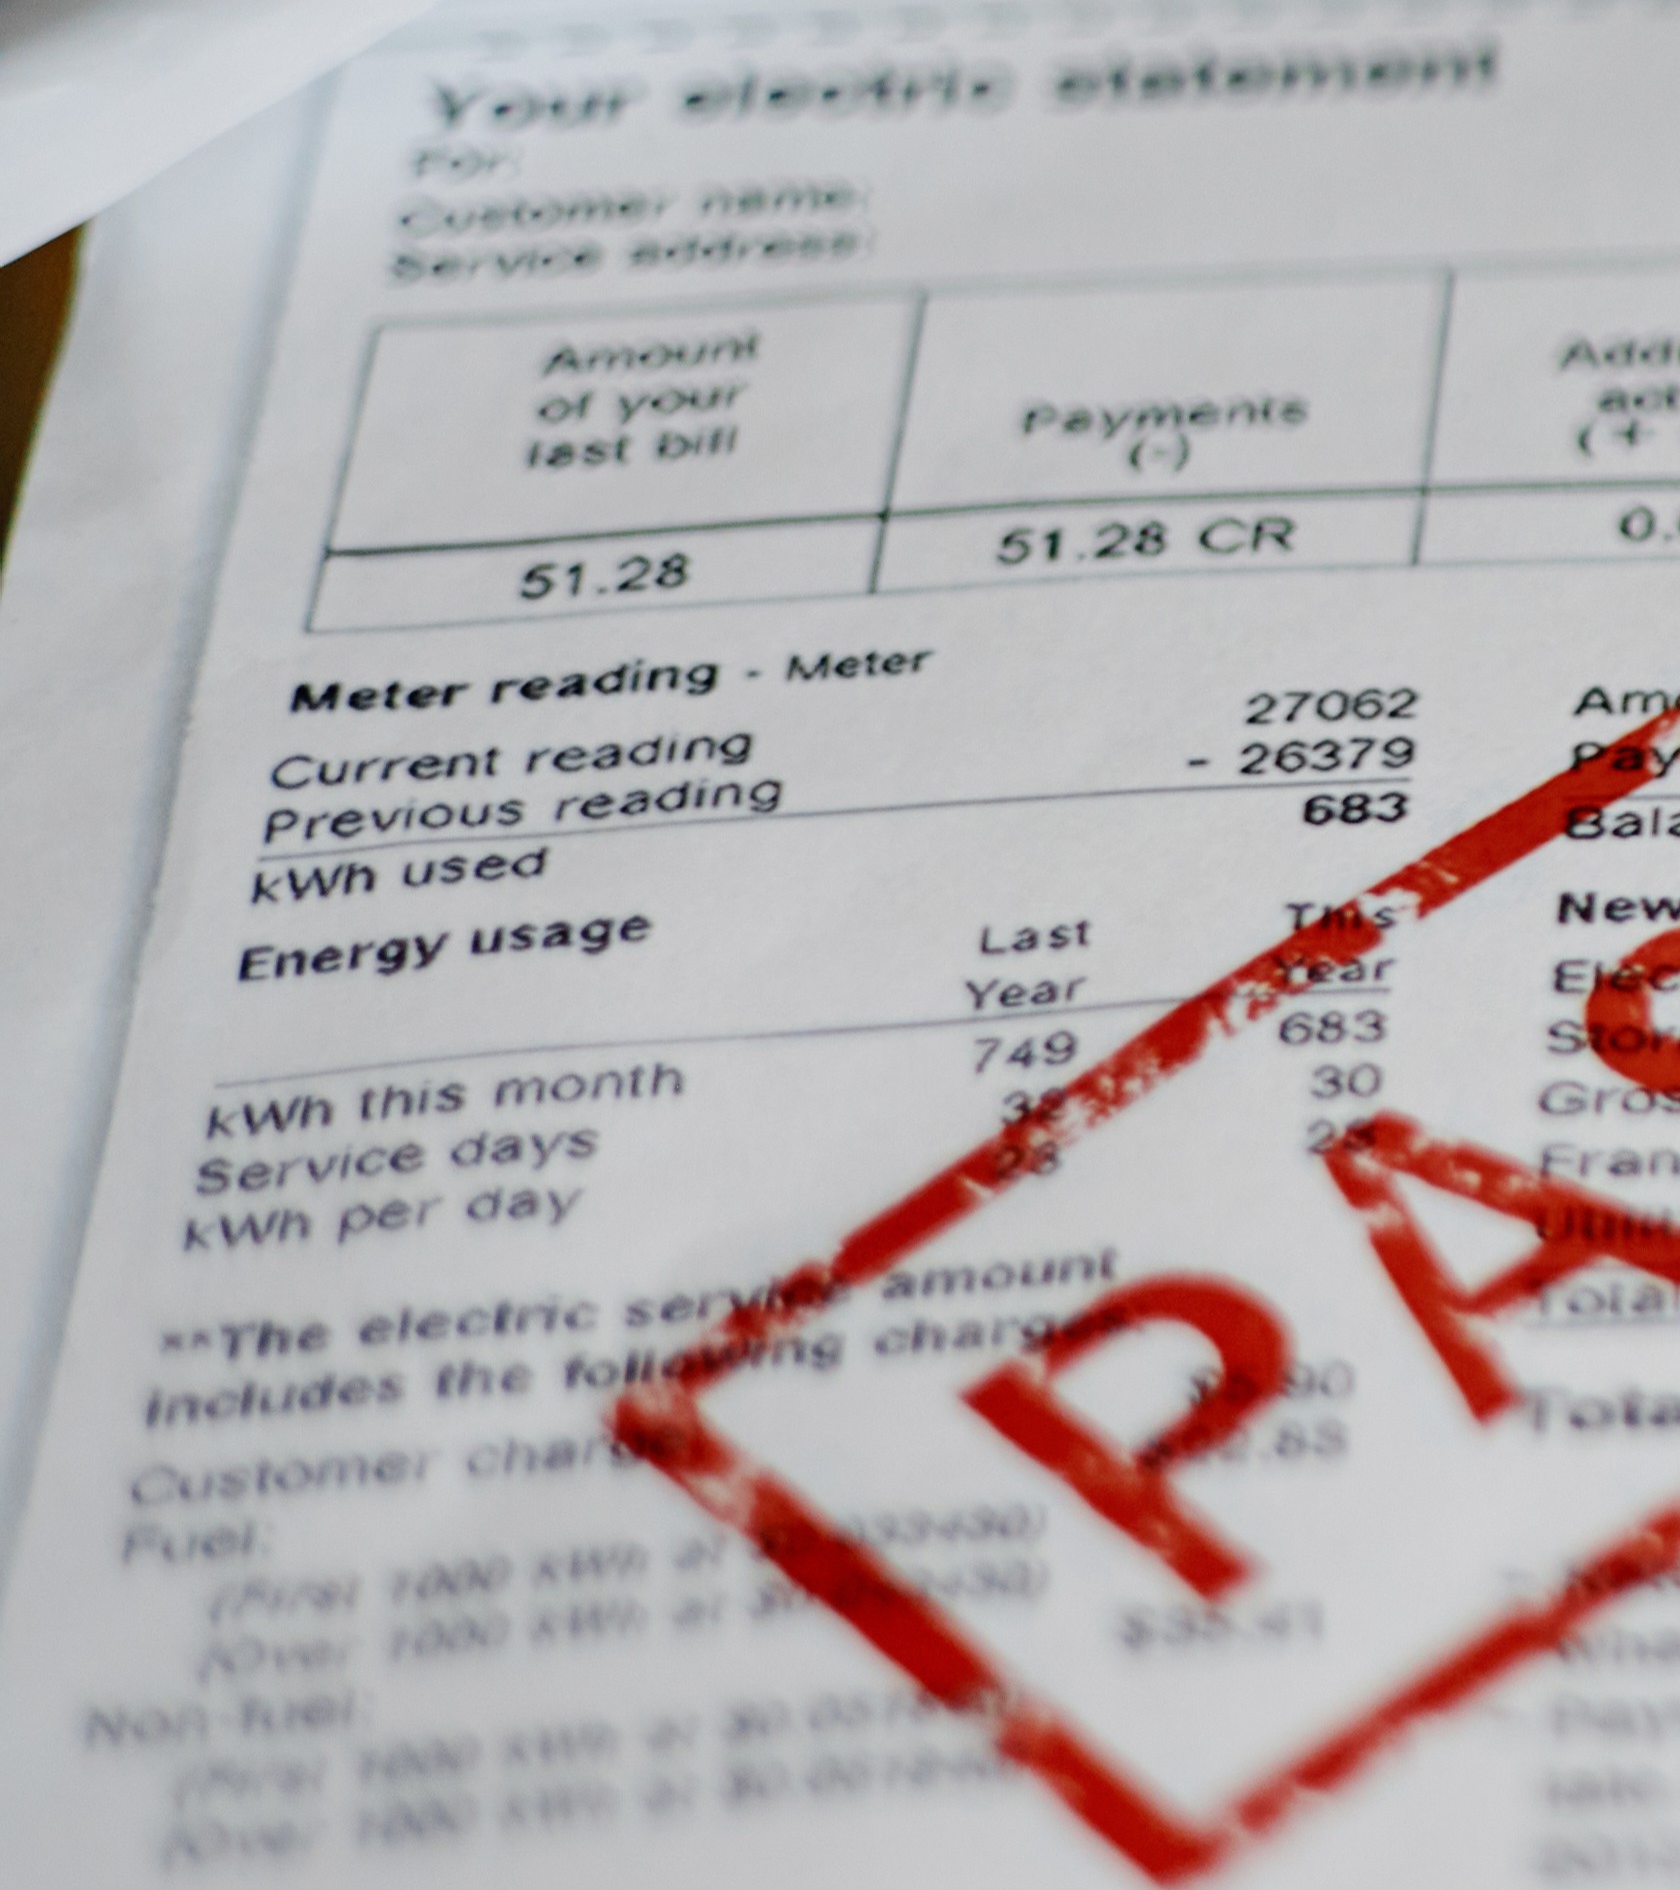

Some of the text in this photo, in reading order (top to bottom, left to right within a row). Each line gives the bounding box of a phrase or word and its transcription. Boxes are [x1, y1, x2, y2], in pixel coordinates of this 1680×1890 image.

[430, 34, 1502, 132] Your electric statement
[541, 331, 762, 377] Amount
[535, 382, 750, 426] of your
[1021, 398, 1311, 442] Payments
[525, 425, 740, 471] last bill
[996, 514, 1299, 567] 51.28 CR
[518, 550, 692, 604] 51.28
[288, 647, 935, 715] Meter reading Meter
[1246, 686, 1421, 727] 27062
[269, 728, 756, 794] Current reading
[1238, 735, 1418, 777] 26379
[262, 775, 785, 847] Previous reading
[1303, 790, 1411, 827] 683
[250, 845, 550, 907] kWh used
[237, 911, 655, 985] Energy usage
[979, 918, 1092, 958] Last
[965, 974, 1089, 1012] Year
[974, 1029, 1081, 1076] 749
[1278, 1007, 1389, 1048] 683
[205, 1059, 687, 1143] kWh this month
[1310, 1063, 1384, 1101] 30
[196, 1123, 602, 1198] Service days
[181, 1182, 586, 1254] kWh per day
[356, 1246, 1120, 1348] electric amount
[143, 1358, 538, 1430] includes the
[129, 1446, 432, 1508] Customer
